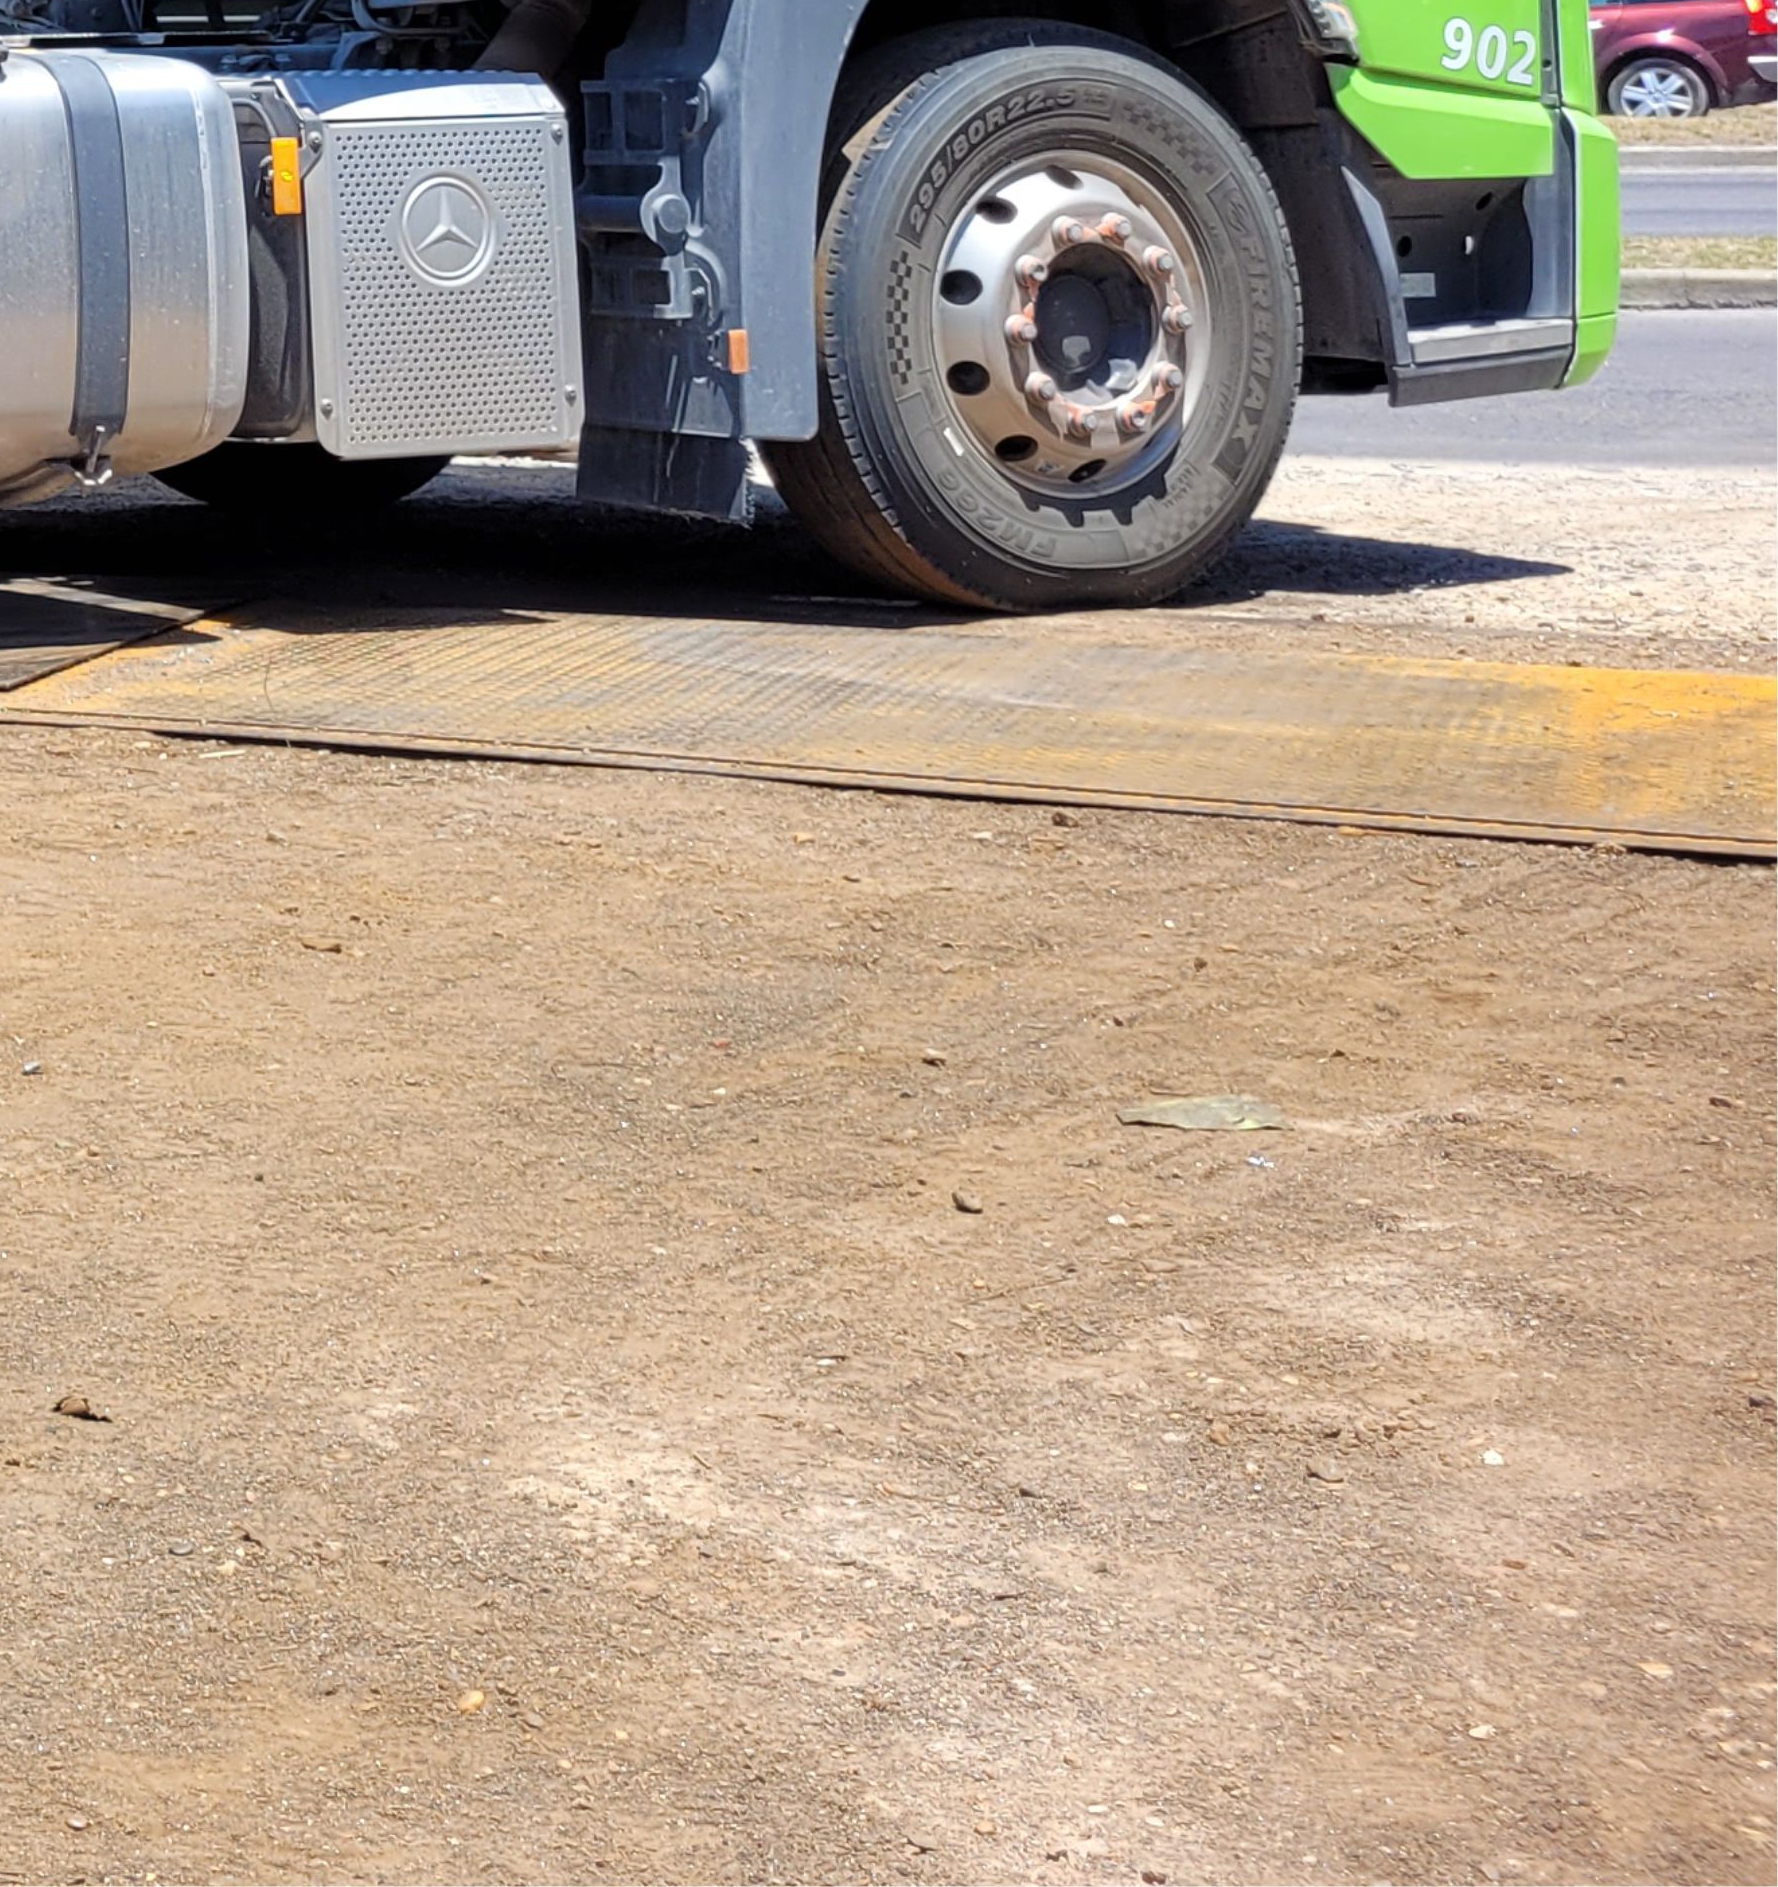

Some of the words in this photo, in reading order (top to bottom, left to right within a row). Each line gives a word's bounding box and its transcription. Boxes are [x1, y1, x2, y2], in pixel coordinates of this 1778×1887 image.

[1440, 16, 1536, 86] 902
[910, 87, 1076, 233] 295/80R22.5
[1232, 241, 1276, 451] FIREMAX
